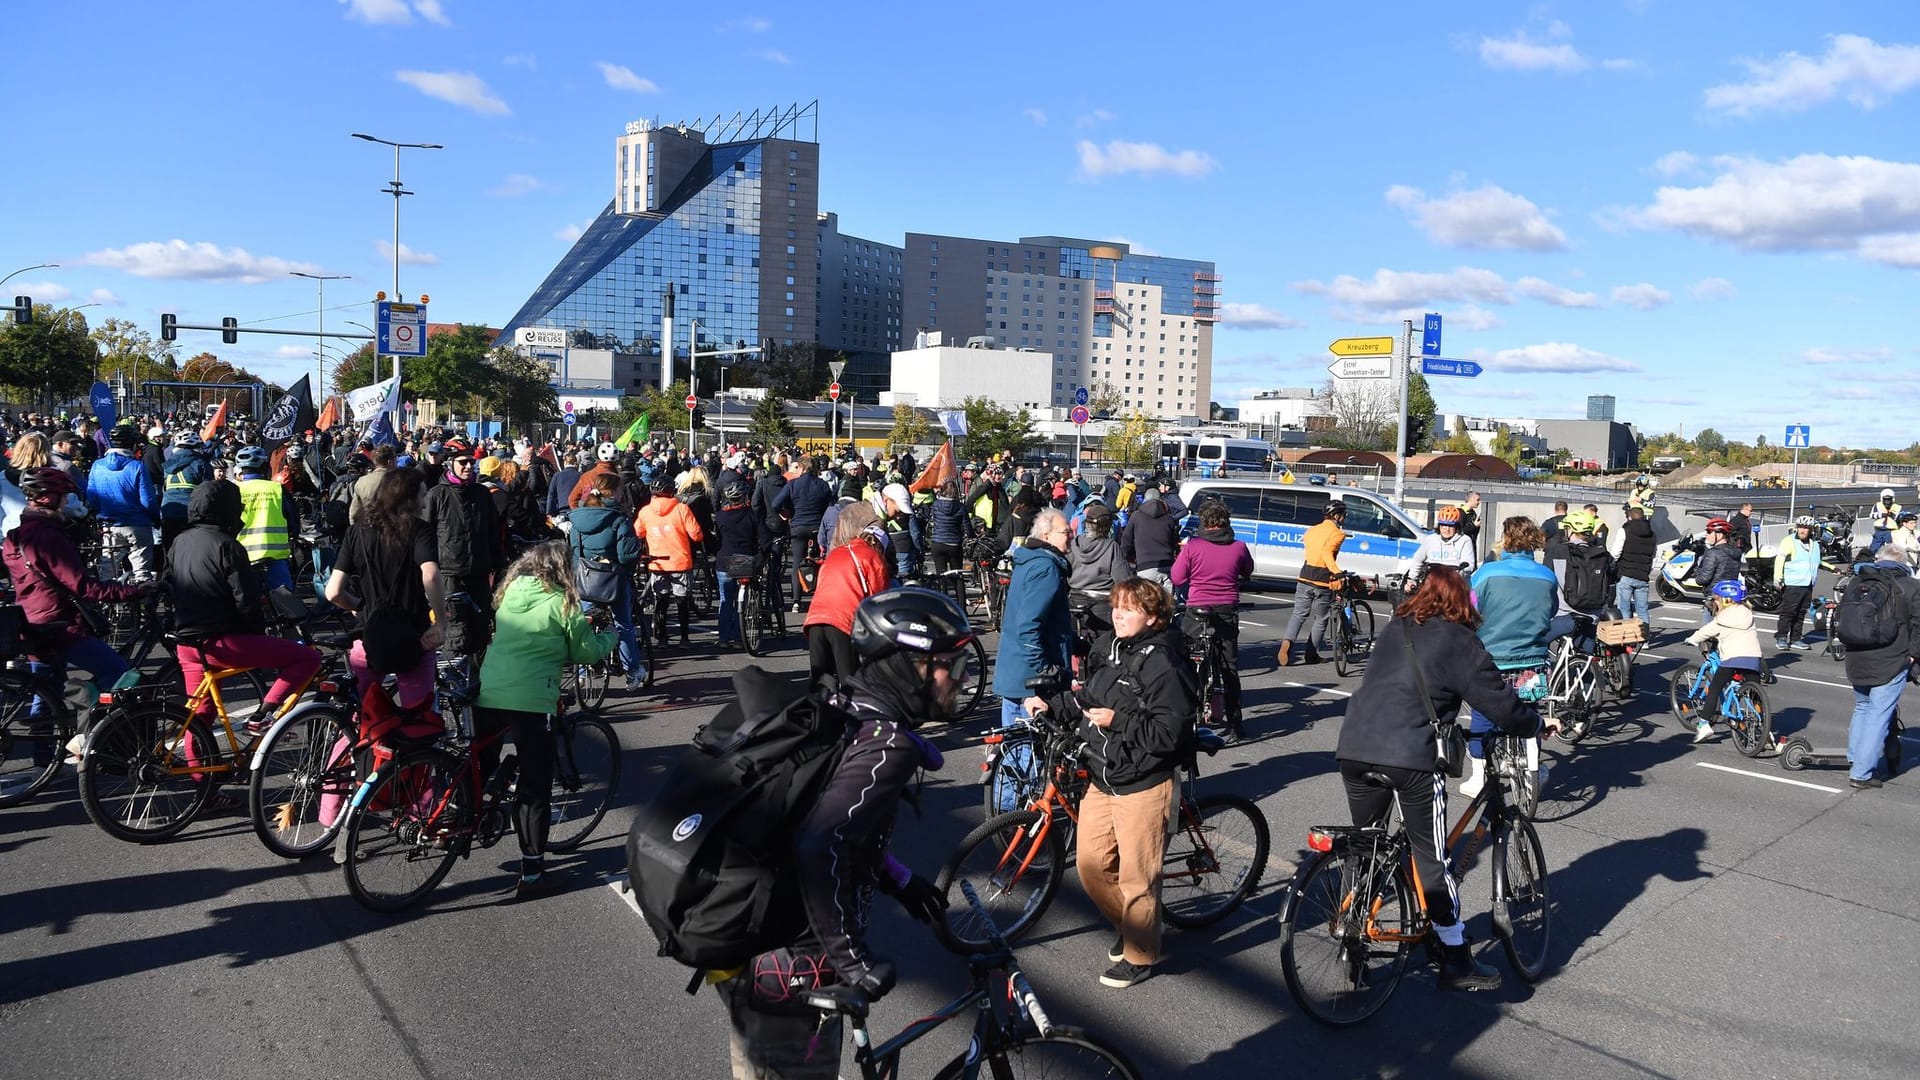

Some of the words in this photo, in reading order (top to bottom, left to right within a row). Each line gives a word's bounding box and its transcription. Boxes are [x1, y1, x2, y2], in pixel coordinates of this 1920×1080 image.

[1428, 320, 1438, 330] U5
[537, 335, 563, 343] REUSS
[1343, 360, 1357, 368] Estrel
[1343, 368, 1385, 376] Convention-Center
[805, 442, 850, 453] DACHSE
[1269, 531, 1303, 544] POLIZ
